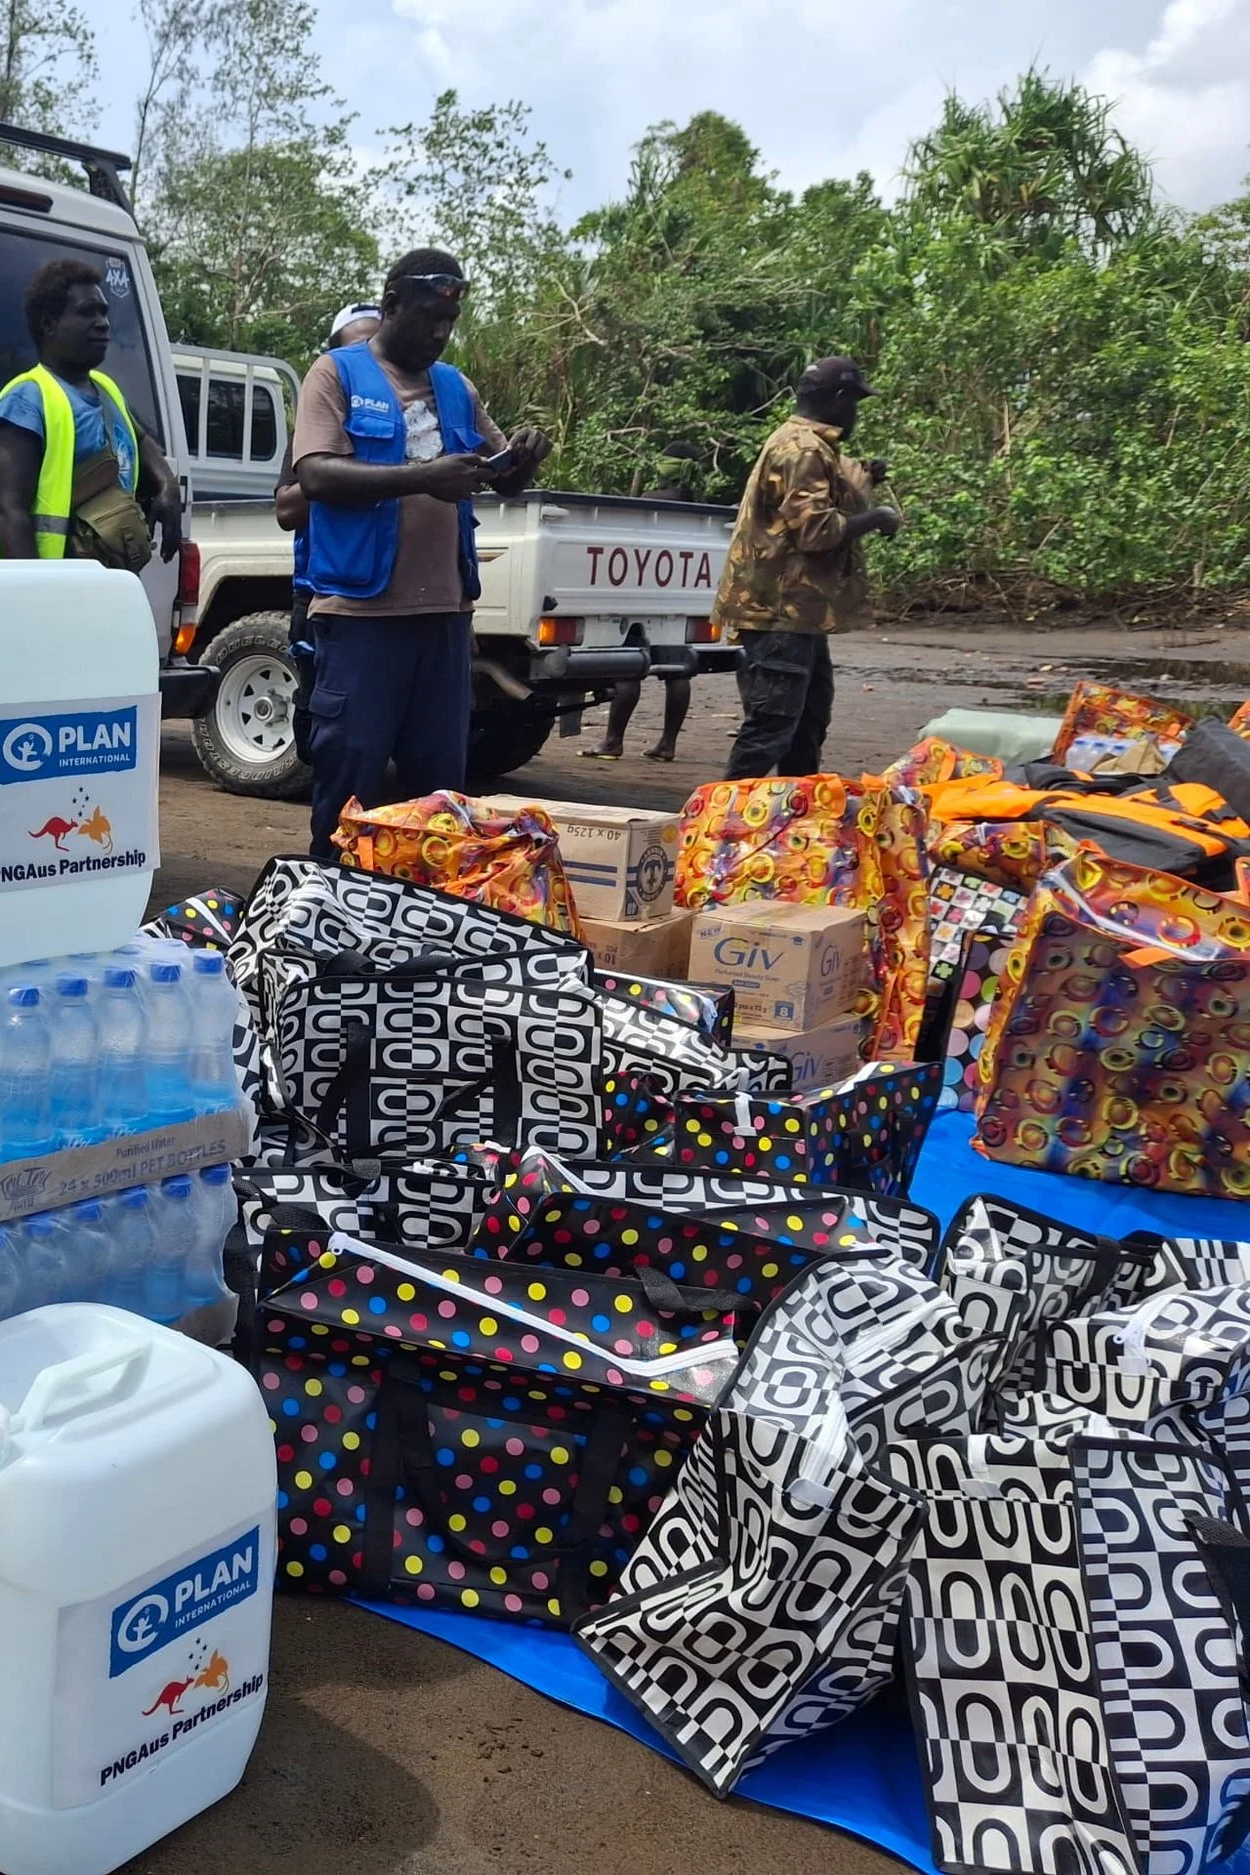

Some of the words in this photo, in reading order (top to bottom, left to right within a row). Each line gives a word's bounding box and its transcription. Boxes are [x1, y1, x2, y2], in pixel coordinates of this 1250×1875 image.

[587, 547, 711, 588] TOYOTA
[59, 722, 131, 753] PLAN
[59, 753, 131, 767] INTERNATIONAL
[59, 849, 146, 875] Partnership
[714, 936, 785, 970] Giv
[174, 1546, 253, 1613] PLAN
[175, 1581, 251, 1629] INTERNATIONAL
[100, 1732, 170, 1787] PNGAus
[172, 1673, 264, 1740] Partnership
